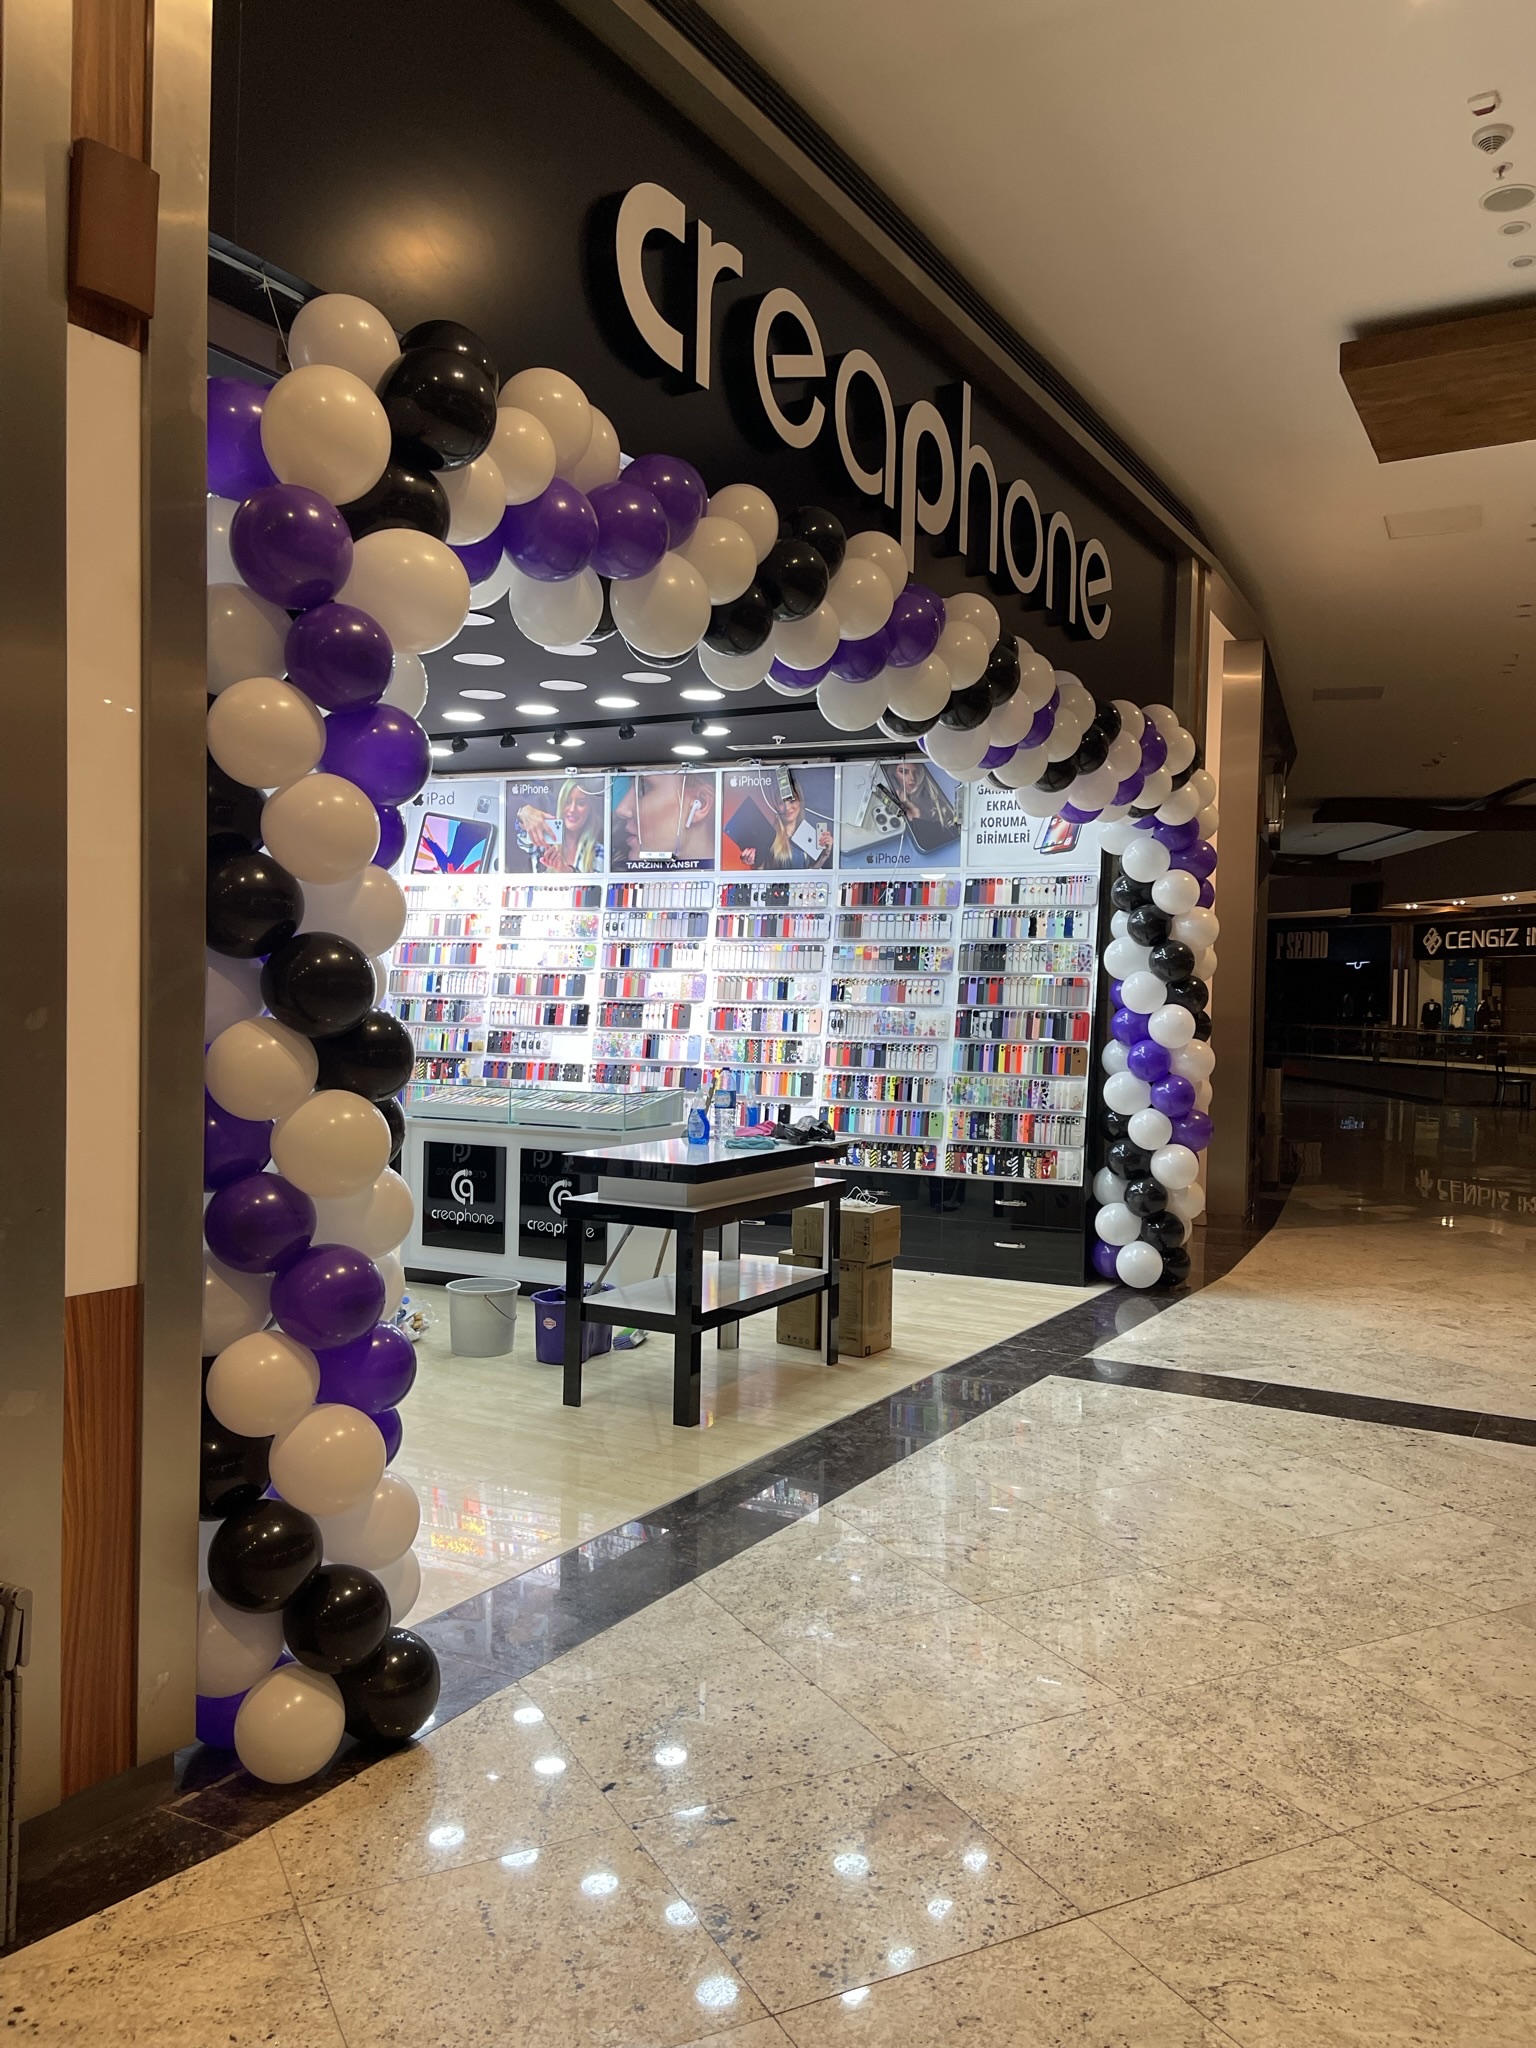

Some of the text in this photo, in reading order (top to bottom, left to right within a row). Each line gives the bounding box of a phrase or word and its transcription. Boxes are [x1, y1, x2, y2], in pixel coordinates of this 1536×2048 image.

[615, 181, 1113, 640] creaphone
[738, 775, 772, 787] iPhone
[519, 783, 549, 795] iPhone
[426, 791, 455, 806] iPad
[980, 816, 1028, 828] KORUMA
[976, 829, 1031, 844] BİRİMLERİ
[874, 852, 911, 864] iPhone
[431, 1207, 495, 1225] creaphone
